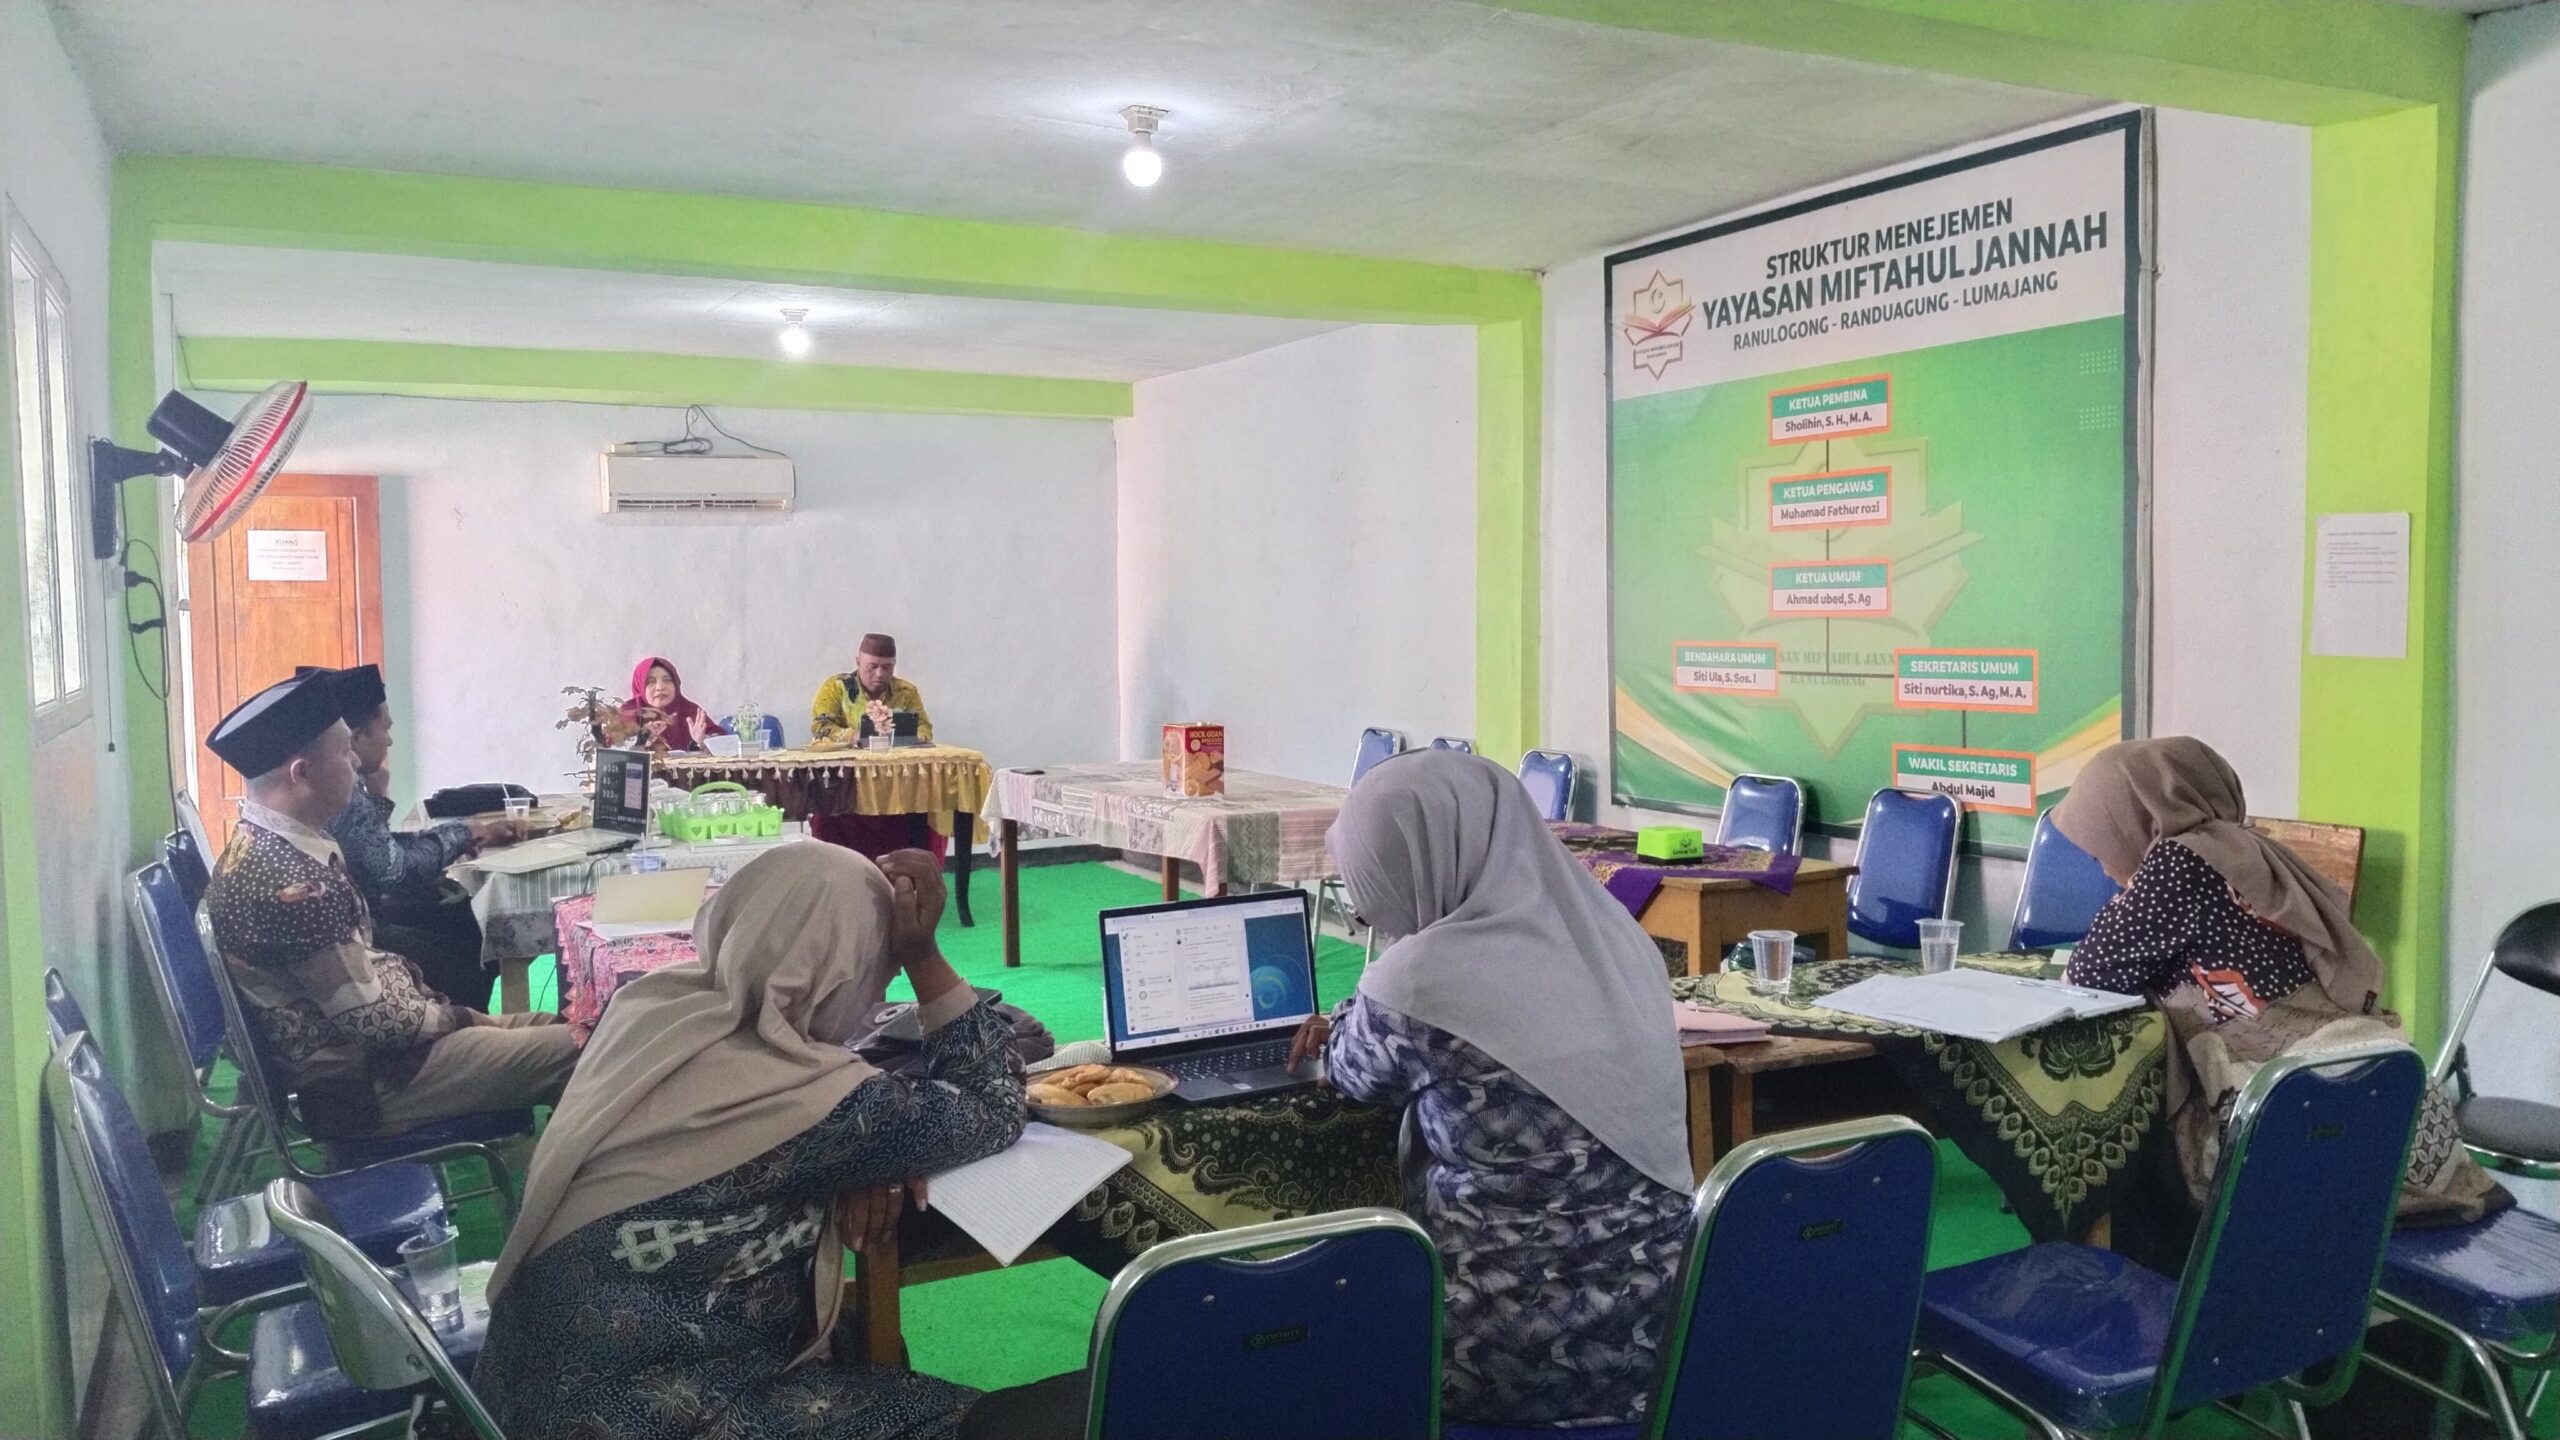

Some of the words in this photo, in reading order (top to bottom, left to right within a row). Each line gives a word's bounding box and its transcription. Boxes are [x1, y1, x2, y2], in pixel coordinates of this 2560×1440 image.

[1766, 232, 1870, 279] STRUKTUR
[1875, 197, 2013, 254] MENEJEMEN
[1702, 277, 1813, 330] YAYASAN
[1820, 245, 1965, 306] MIFTAHUL
[1969, 210, 2107, 276] JANNAH
[1733, 316, 1829, 351] RANULOGONG
[1840, 292, 1949, 330] RANDUAGUNG
[1962, 271, 2058, 307] LUMAJANG
[1789, 395, 1821, 411] KETUA
[1822, 388, 1868, 406] PEMBINA
[1783, 486, 1816, 499] KETUA
[1816, 480, 1874, 495] PENGAWAS
[1780, 506, 1826, 520] Muhamad
[1827, 503, 1860, 516] Fathur
[1861, 500, 1880, 513] rozi
[1795, 572, 1829, 585] KETUA
[1829, 570, 1861, 583] UMUM
[1786, 593, 1819, 605] Ahmad
[1858, 593, 1872, 606] Ag
[1684, 651, 1737, 664] BENDAHARA
[1737, 652, 1766, 664] UMUM
[1693, 670, 1708, 682] Siti
[1910, 660, 1979, 674] SEKRETARIS
[1980, 662, 2019, 675] UMUM
[1904, 682, 1923, 695] Siti
[1206, 730, 1223, 738] GUAN
[1908, 756, 1947, 771] WAKIL
[1947, 759, 2018, 777] SEKRETARIS
[1931, 781, 1964, 796] Abdul
[1965, 784, 1996, 800] Majid
